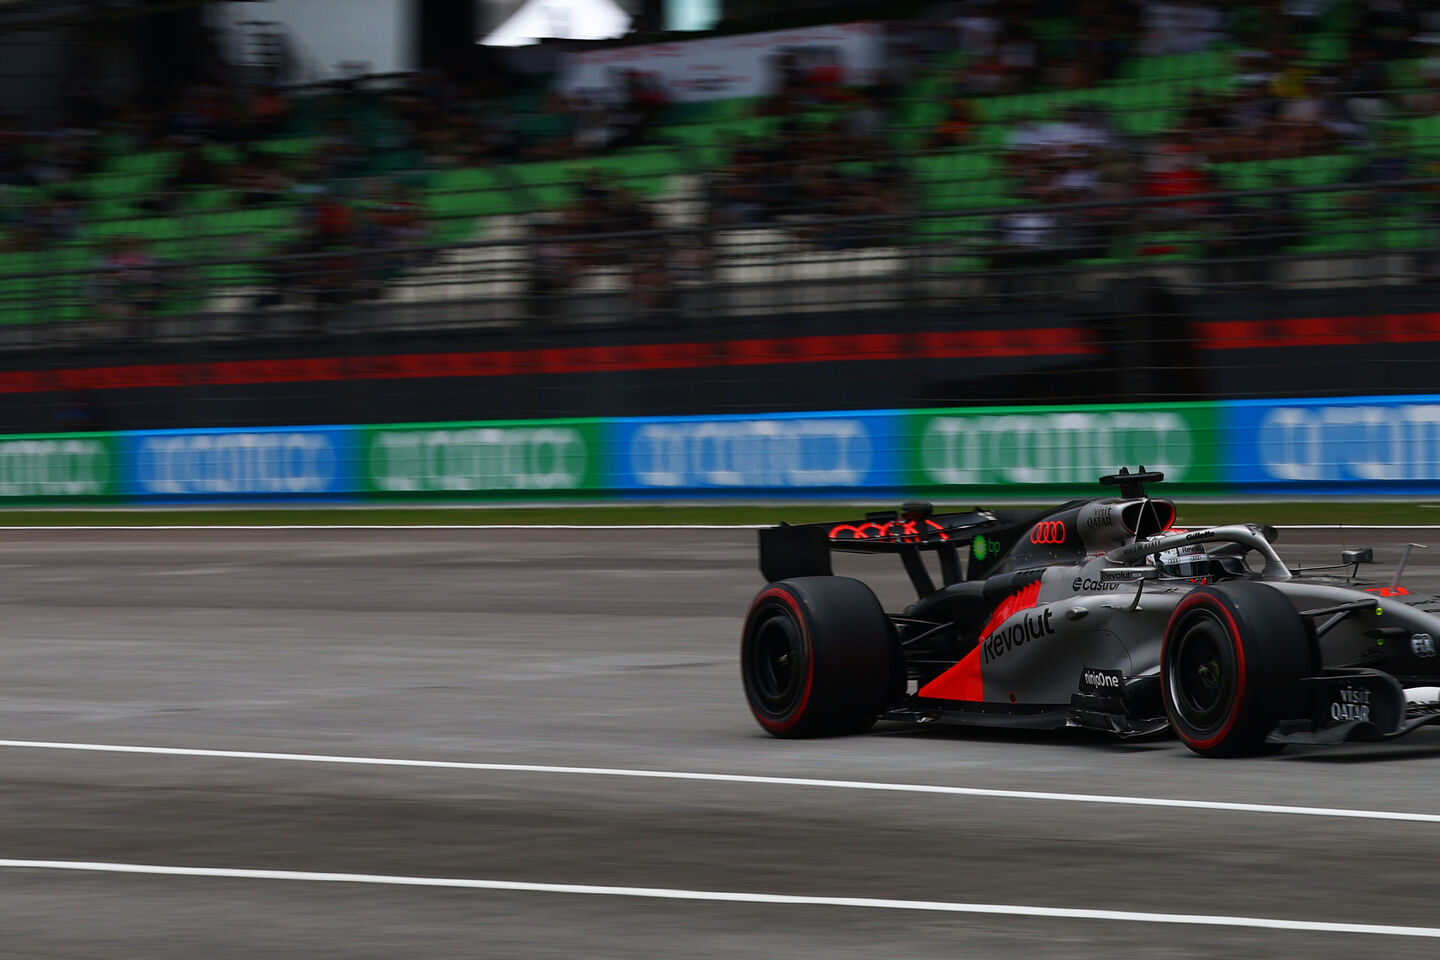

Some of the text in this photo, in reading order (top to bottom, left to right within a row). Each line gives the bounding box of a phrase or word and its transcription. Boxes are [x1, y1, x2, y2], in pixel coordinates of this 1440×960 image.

[1086, 515, 1113, 529] QATAR
[1186, 530, 1216, 541] Gillette
[987, 538, 1001, 556] bp
[1101, 571, 1132, 581] Revolut
[983, 607, 1056, 664] Revolut
[1084, 670, 1120, 689] ninjaOne
[1329, 702, 1371, 722] QATAR
